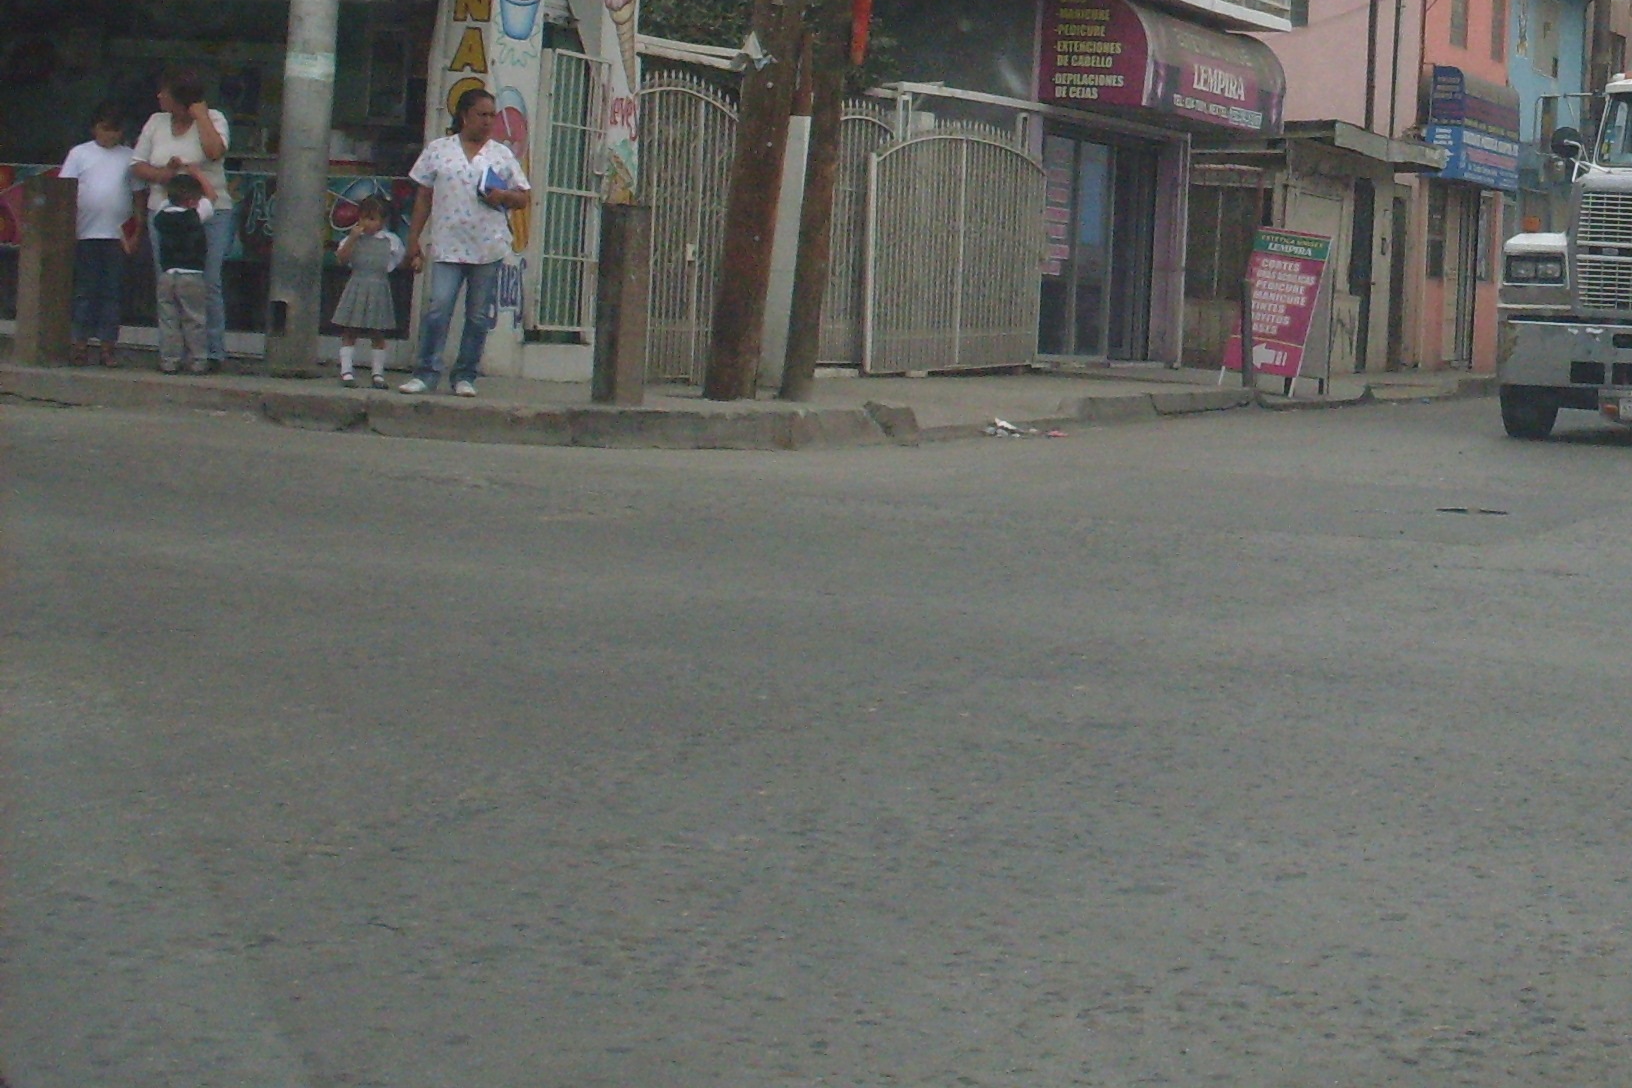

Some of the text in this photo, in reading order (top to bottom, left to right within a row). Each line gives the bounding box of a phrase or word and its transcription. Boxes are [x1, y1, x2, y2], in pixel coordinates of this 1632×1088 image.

[1057, 54, 1113, 68] DE CABELLO
[1192, 63, 1246, 102] LEMPIRA
[1055, 86, 1068, 98] DE
[1267, 242, 1313, 257] LEMPIRA
